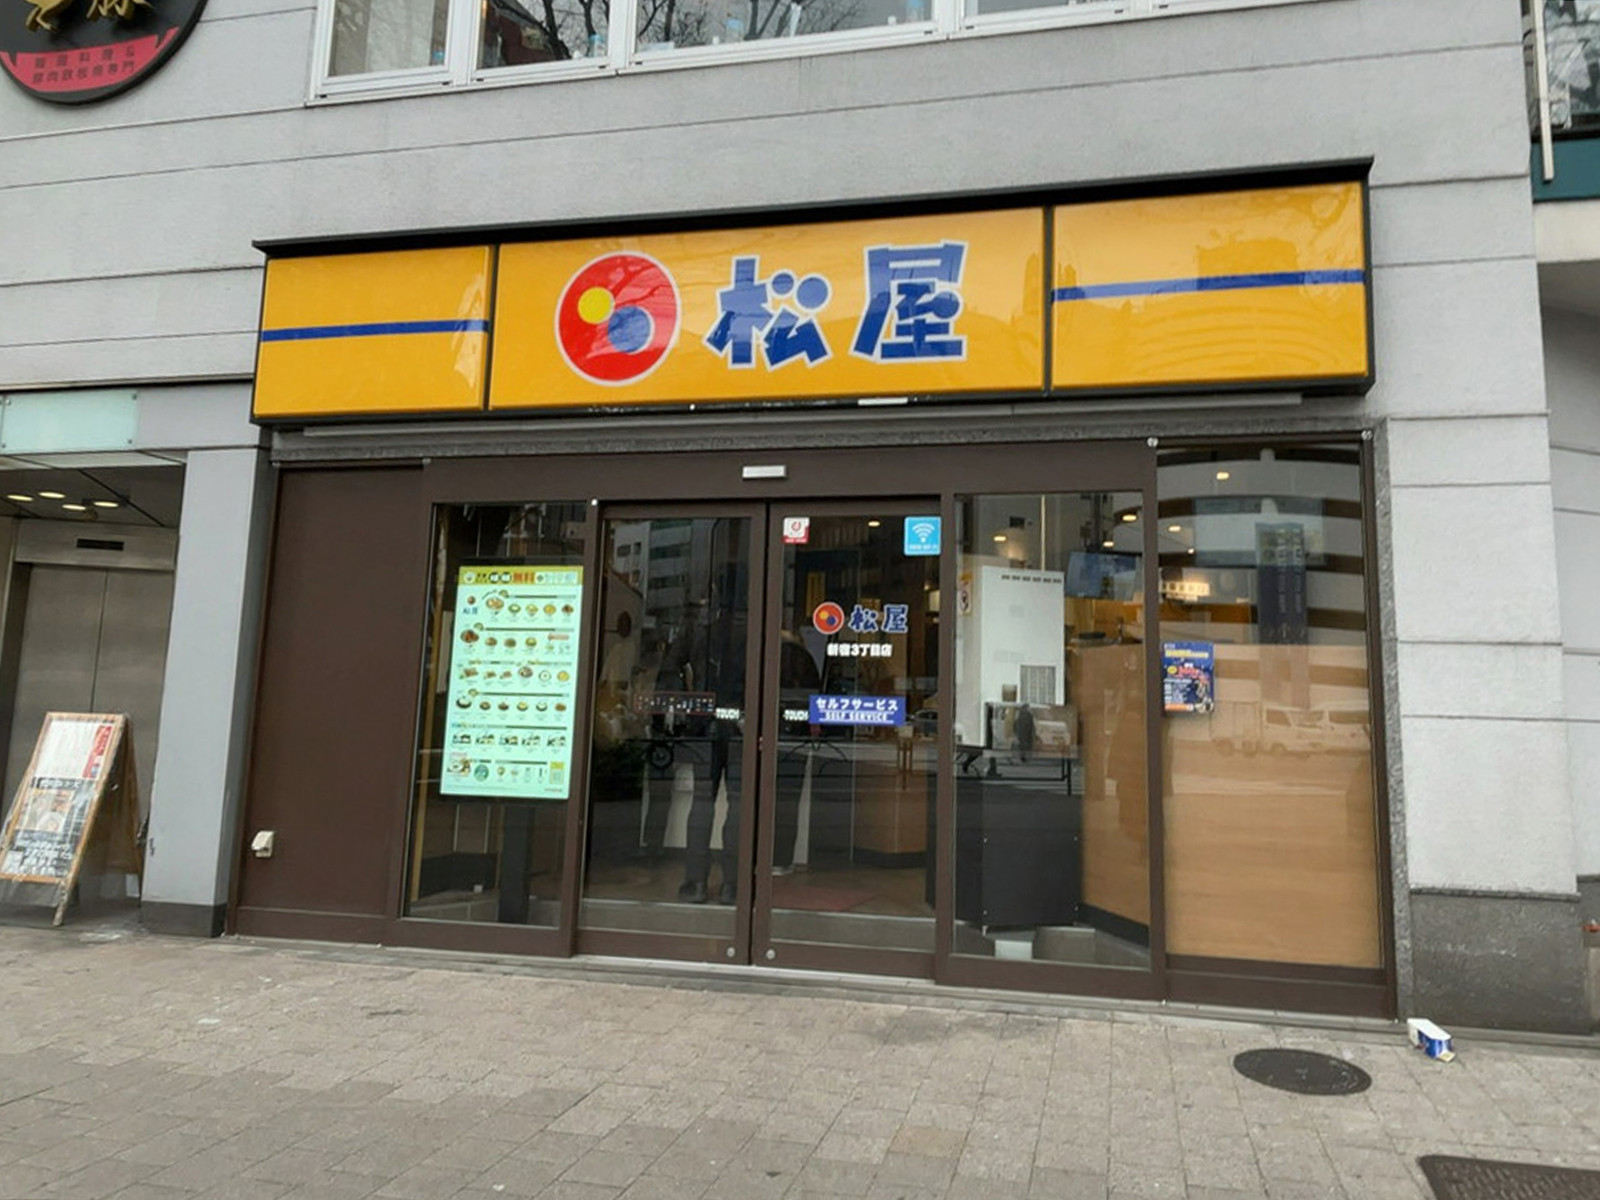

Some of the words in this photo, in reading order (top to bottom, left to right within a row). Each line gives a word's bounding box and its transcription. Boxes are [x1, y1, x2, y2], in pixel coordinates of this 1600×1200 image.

[703, 240, 968, 371] 松屋
[848, 604, 909, 633] 松屋
[816, 697, 898, 711] セルフサービス
[825, 711, 846, 721] SELF
[849, 711, 888, 721] SERVICE
